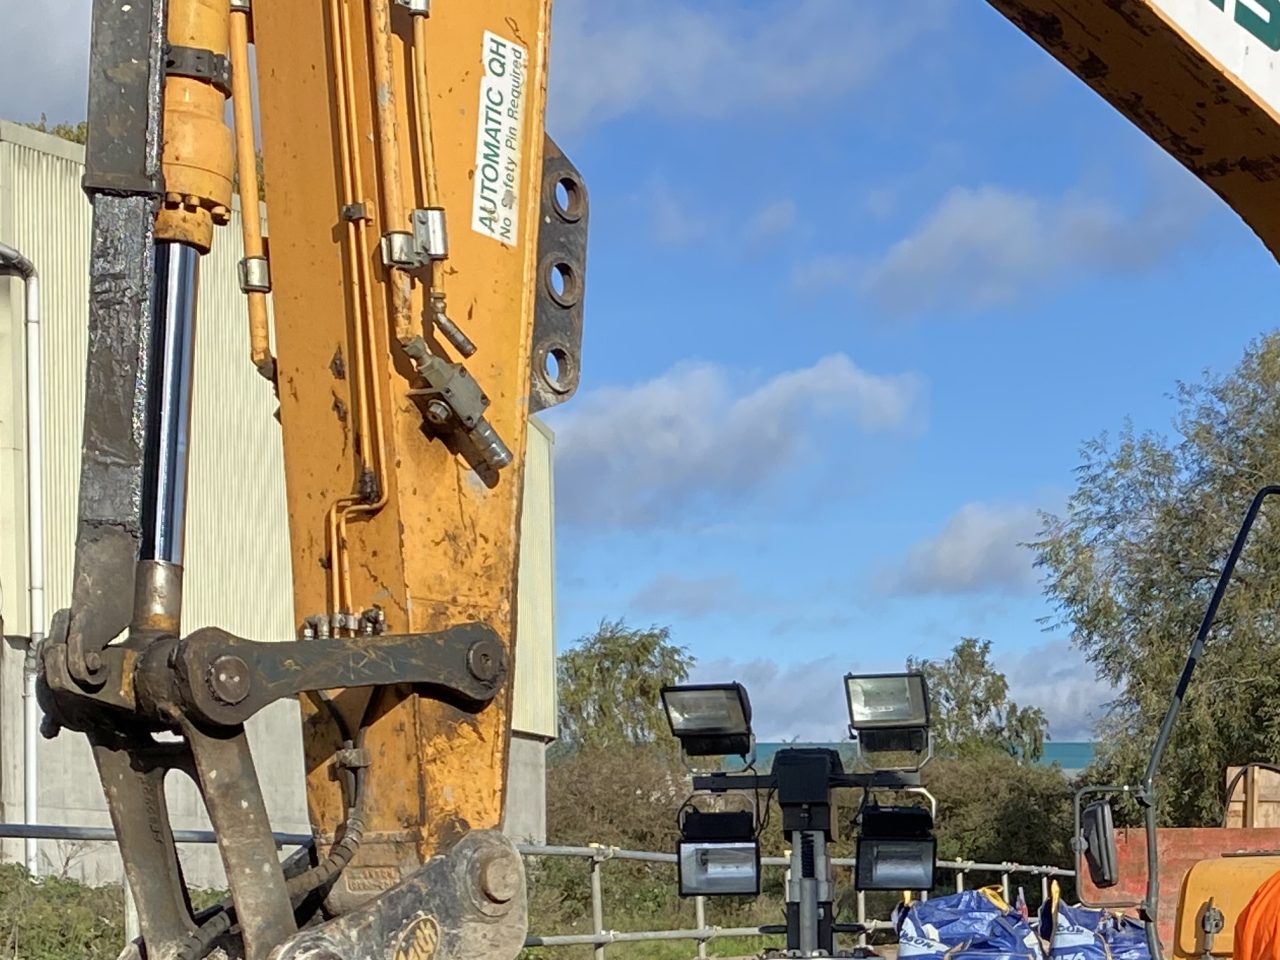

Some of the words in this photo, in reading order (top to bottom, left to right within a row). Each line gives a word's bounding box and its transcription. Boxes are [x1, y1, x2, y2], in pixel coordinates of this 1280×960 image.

[488, 37, 507, 78] QH
[507, 48, 523, 119] Required
[505, 126, 518, 151] Pin
[478, 87, 504, 233] AUTOMATIC
[500, 219, 512, 240] No
